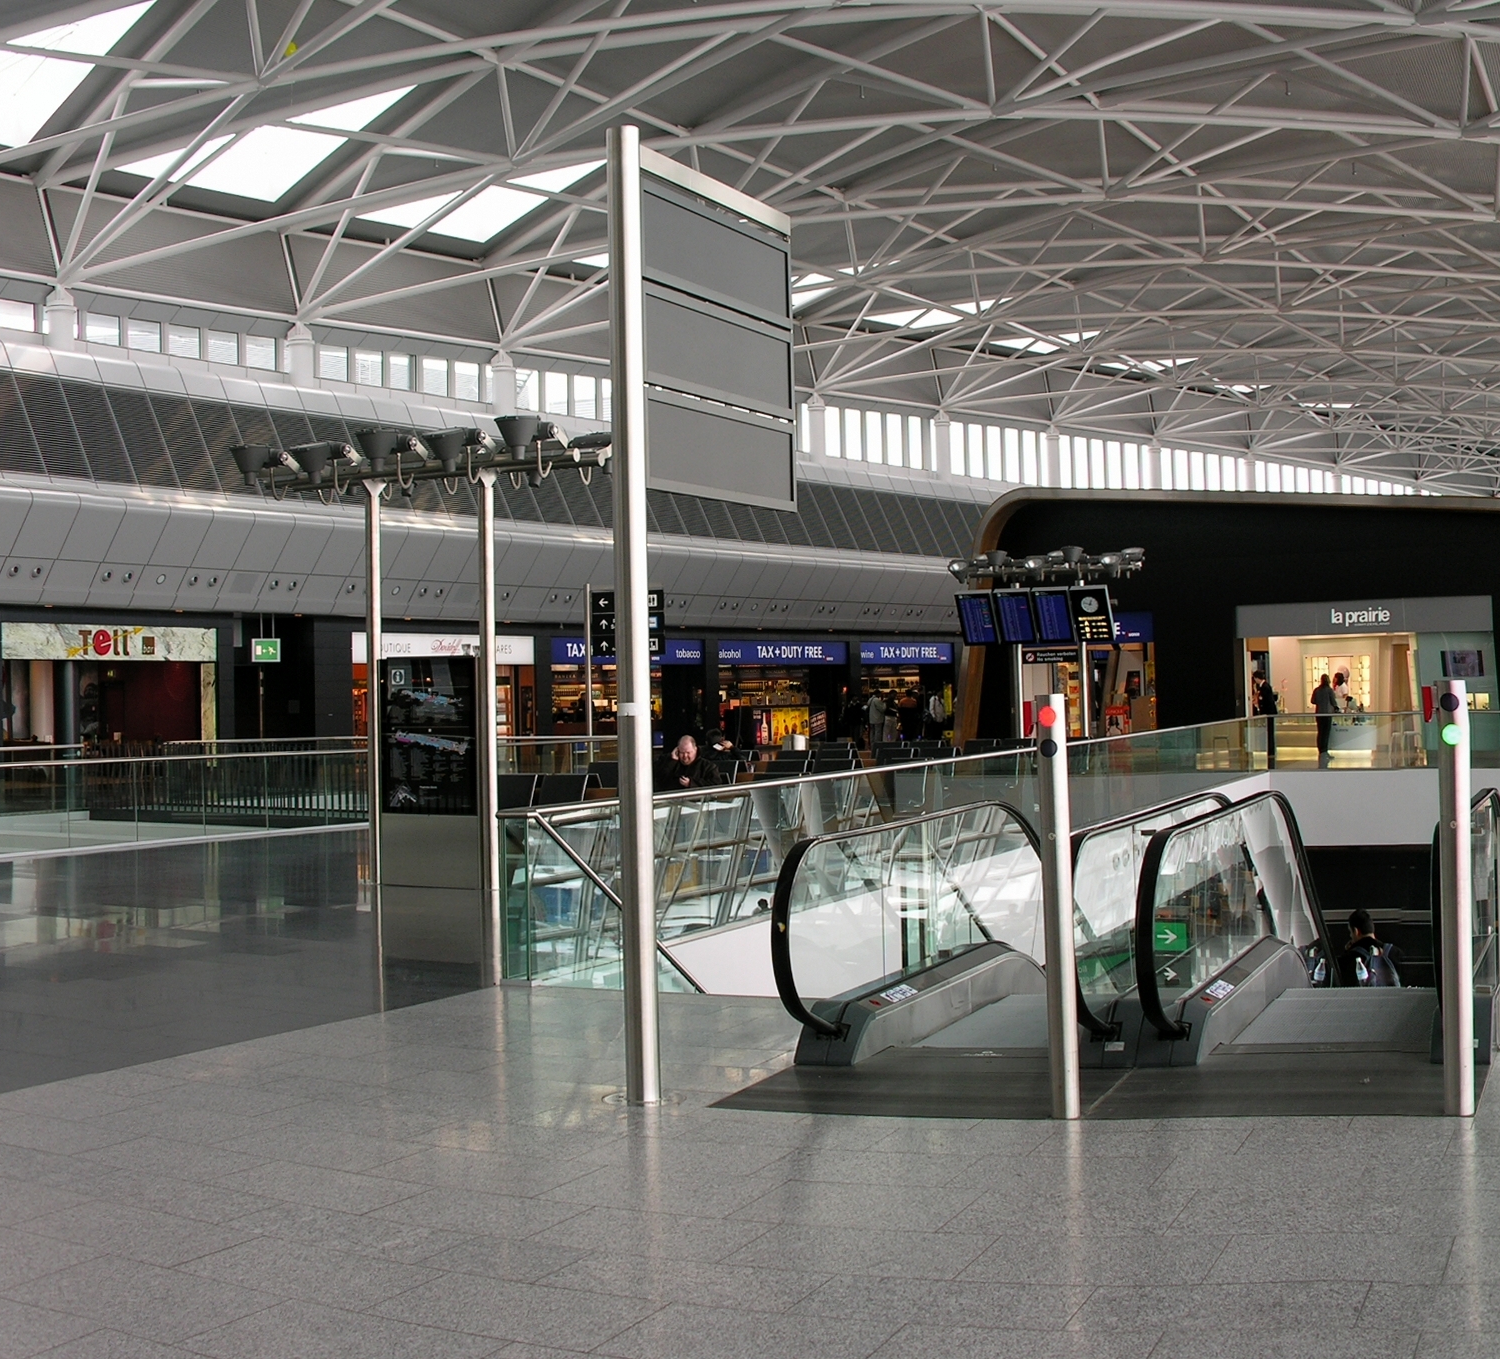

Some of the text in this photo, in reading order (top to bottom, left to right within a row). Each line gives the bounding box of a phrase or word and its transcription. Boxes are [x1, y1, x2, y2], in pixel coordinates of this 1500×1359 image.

[1331, 606, 1390, 627] la prairie
[78, 629, 130, 656] Tell
[381, 642, 411, 654] UTIQUE
[675, 648, 701, 659] tobacco
[718, 648, 742, 659] alcohol
[861, 650, 875, 659] wine
